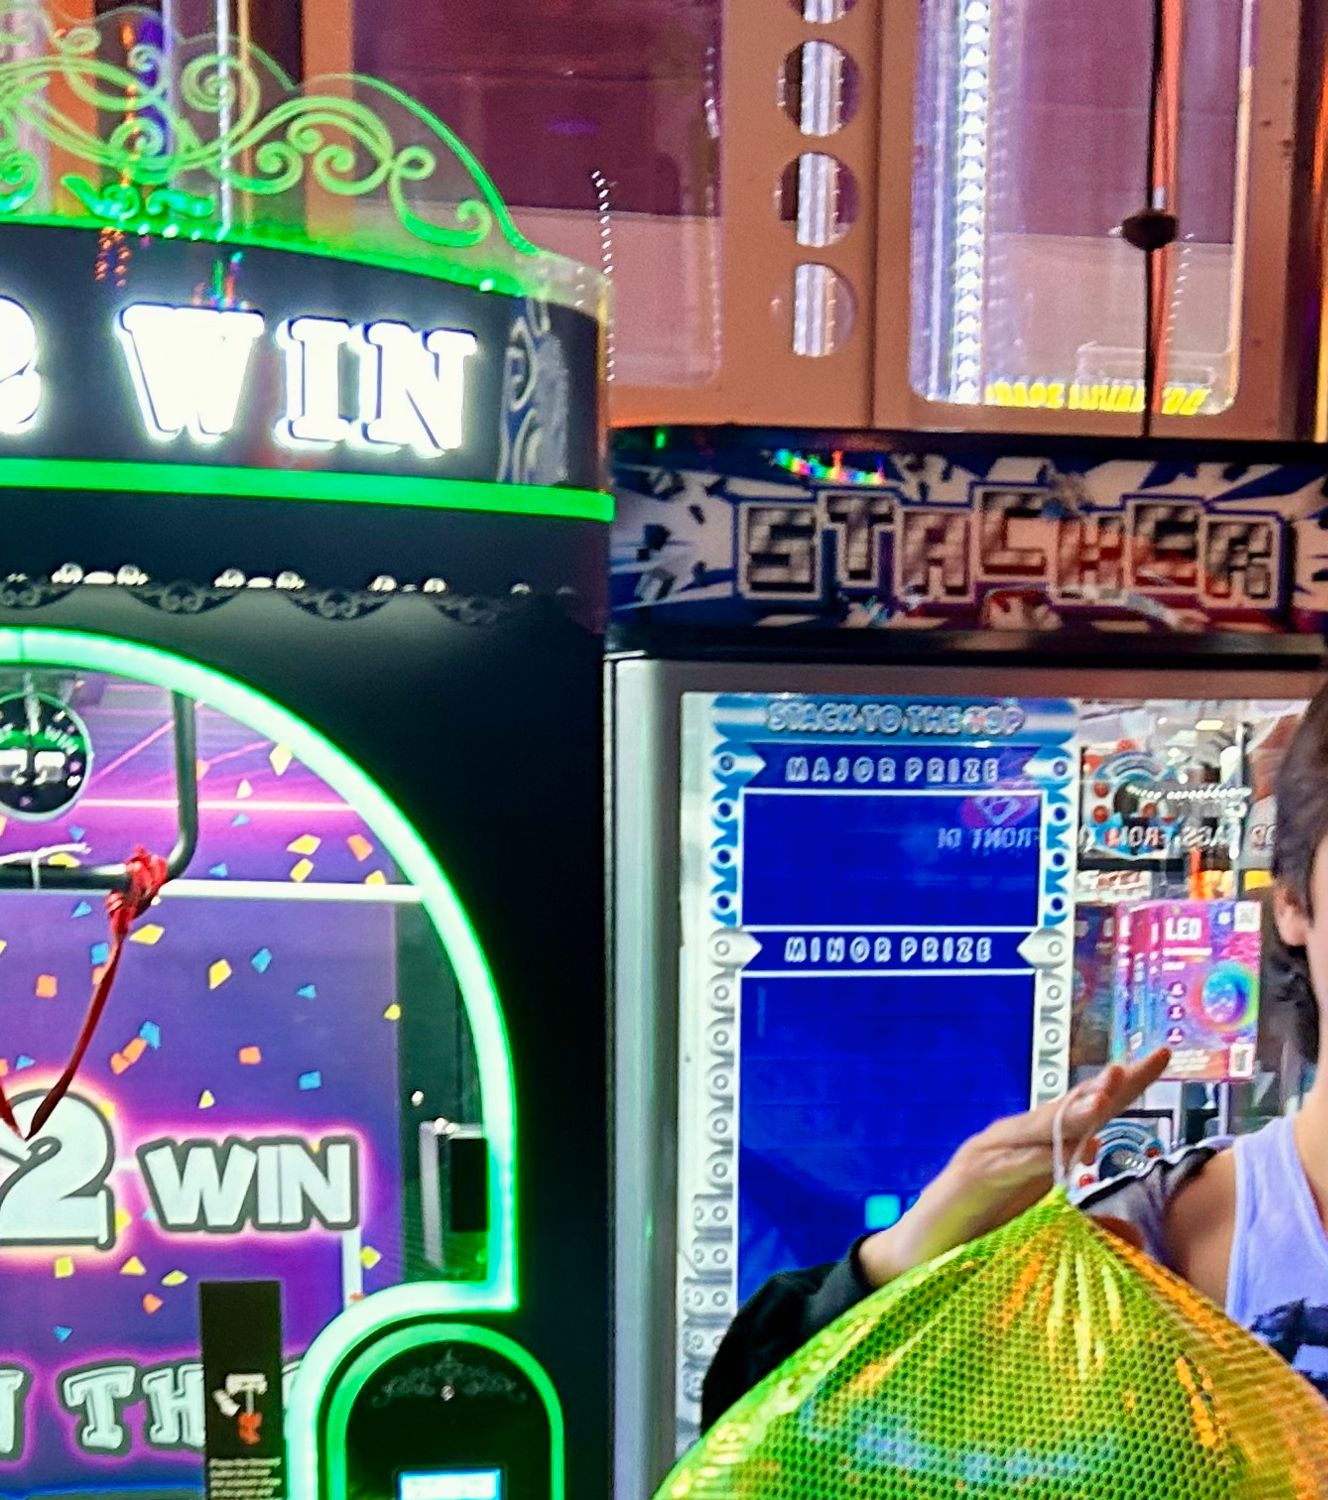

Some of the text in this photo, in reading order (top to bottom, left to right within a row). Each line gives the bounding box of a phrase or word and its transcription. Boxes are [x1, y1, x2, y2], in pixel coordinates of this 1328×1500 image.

[117, 302, 477, 457] WIN
[767, 702, 859, 733] STACK
[861, 703, 904, 734] TO
[906, 704, 962, 735] THE
[785, 756, 1000, 784] MAJOR PRIZE
[1164, 917, 1203, 941] LED
[785, 936, 993, 964] MINOR PRIZE
[138, 1137, 358, 1231] WIN
